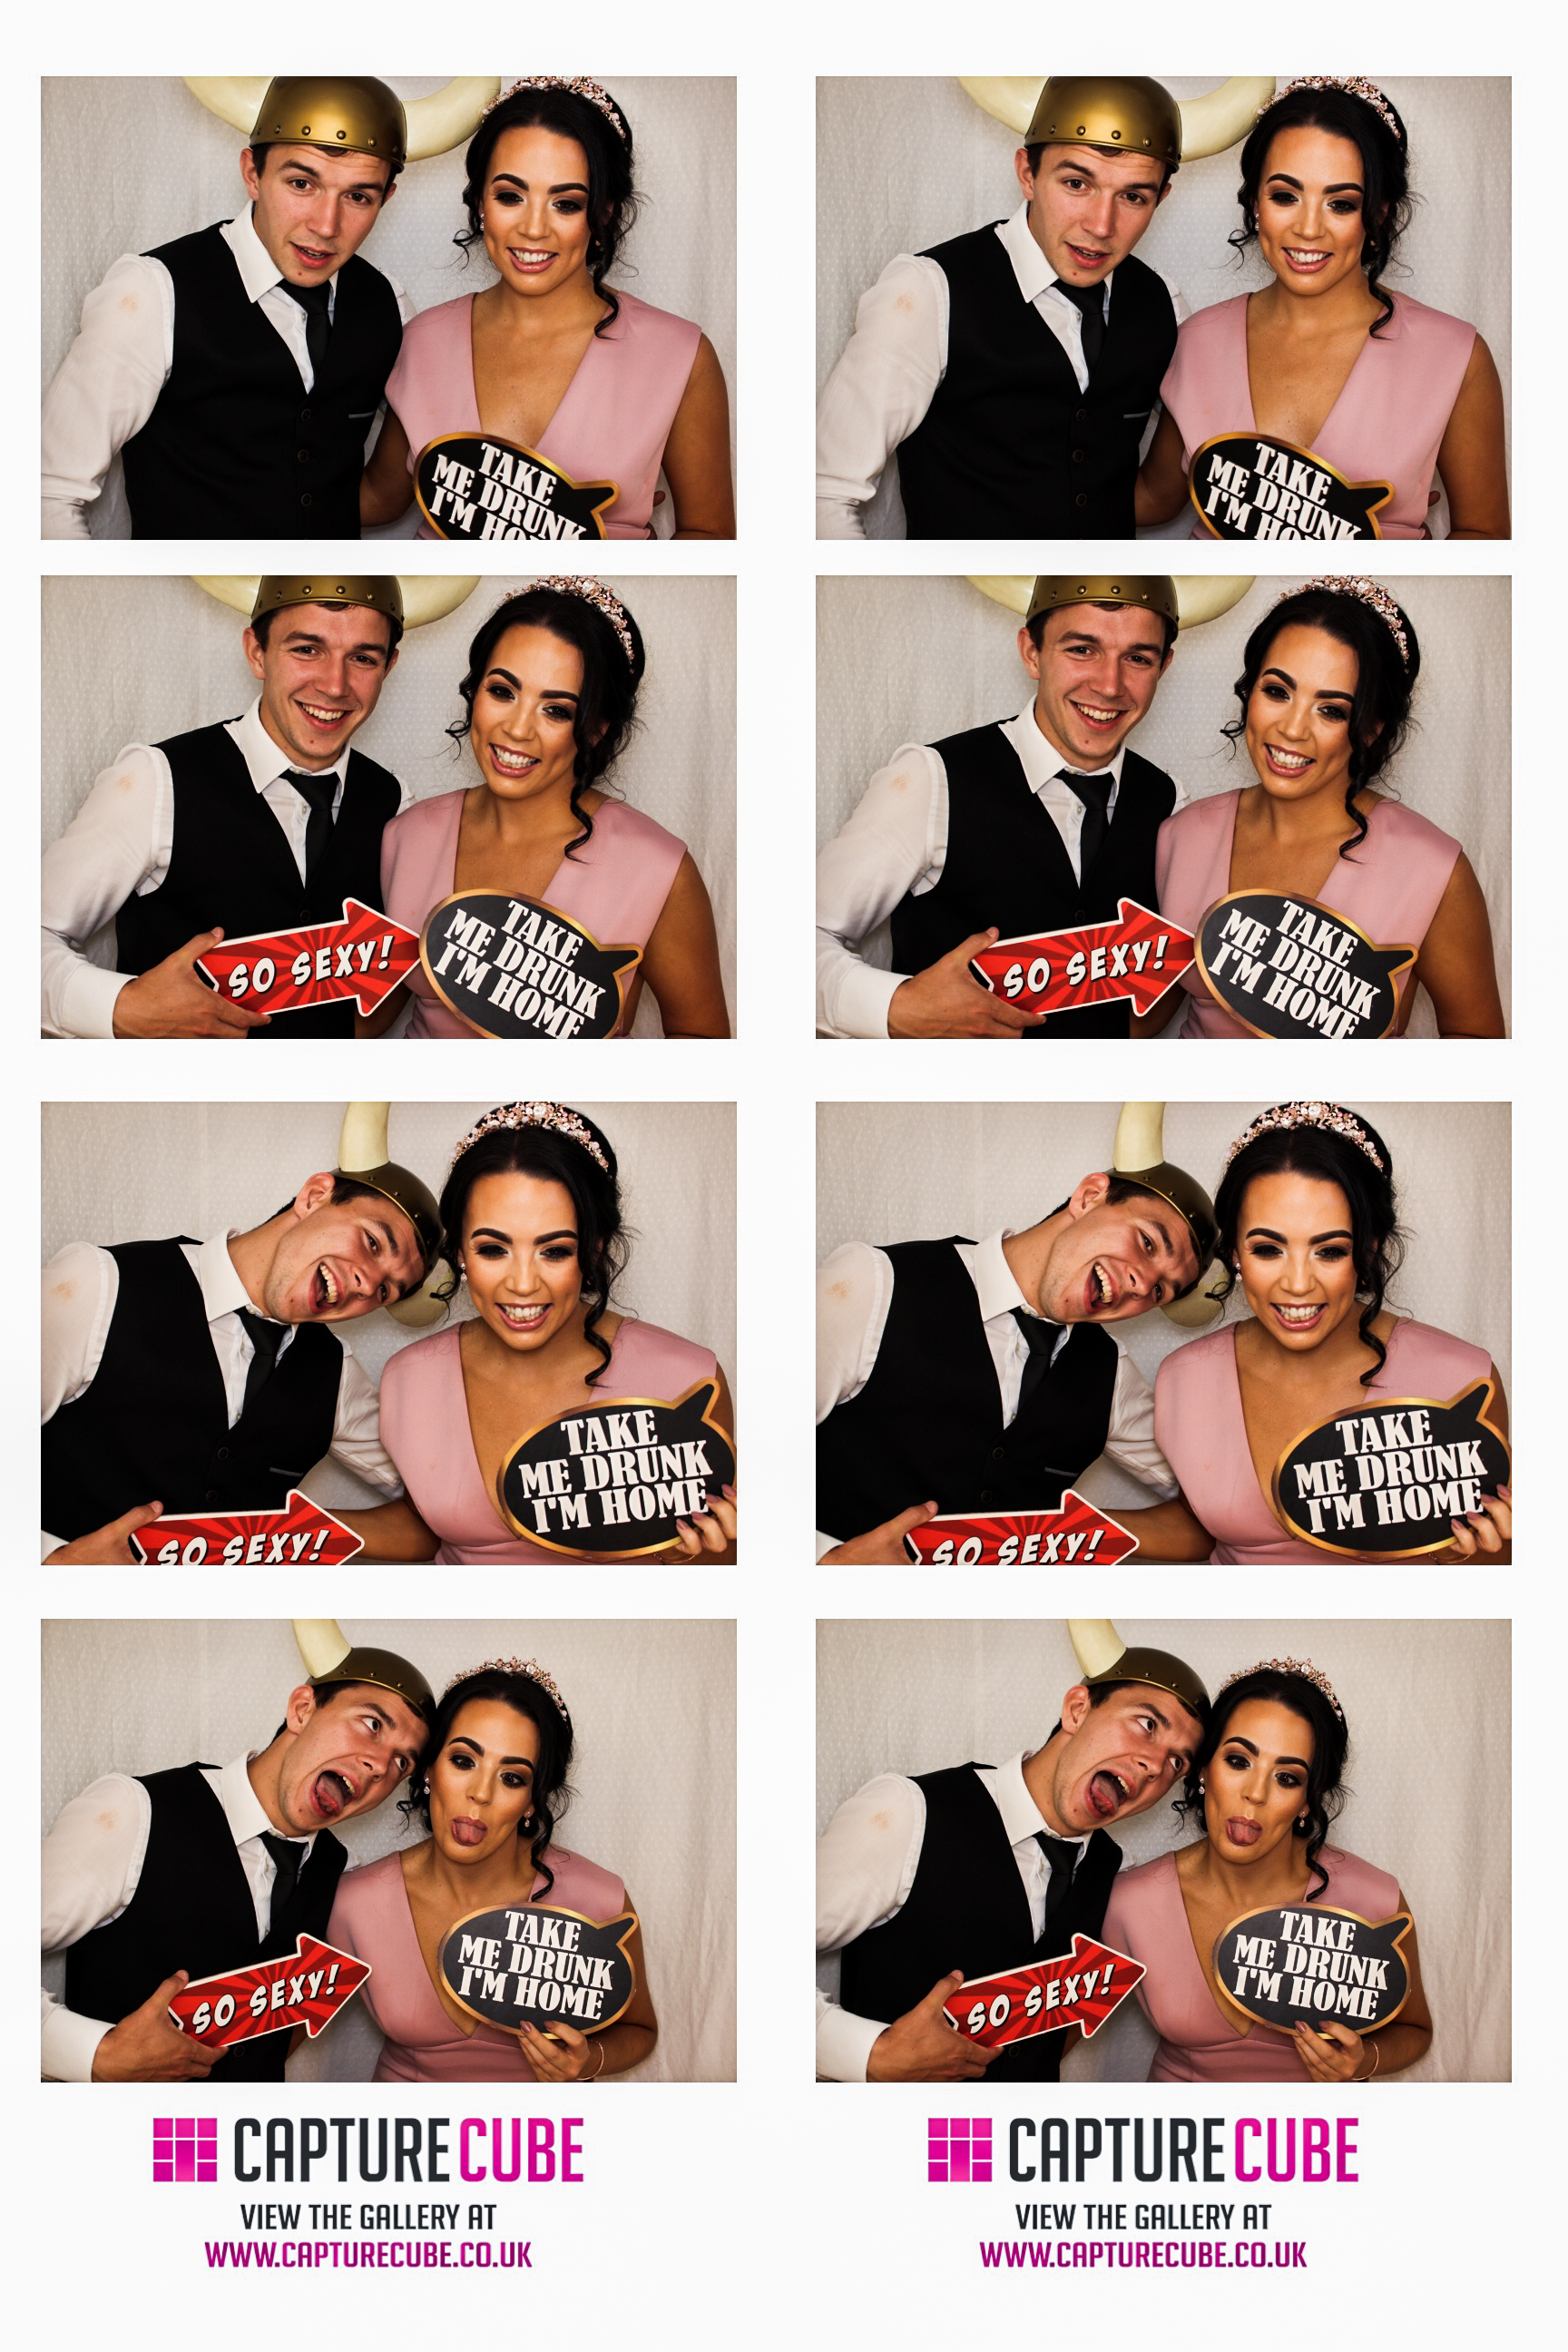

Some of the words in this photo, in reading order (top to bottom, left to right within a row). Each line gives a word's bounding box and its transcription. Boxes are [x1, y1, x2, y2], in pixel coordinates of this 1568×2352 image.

[431, 454, 475, 498] ME
[477, 477, 587, 540] DRUNK
[478, 442, 557, 505] TAKE
[1206, 454, 1250, 498] ME
[1252, 477, 1362, 540] DRUNK
[1253, 442, 1332, 505] TAKE
[429, 485, 477, 533] I'M
[1204, 485, 1252, 533] I'M
[501, 899, 584, 967] TAKE
[1276, 899, 1359, 967] TAKE
[228, 957, 276, 998] SO
[290, 935, 395, 986] SEXY!
[433, 941, 493, 995] I'M
[443, 908, 496, 957] ME
[493, 936, 606, 1020] DRUNK
[1003, 957, 1051, 998] SO
[1065, 935, 1170, 986] SEXY!
[1208, 941, 1268, 995] I'M
[1218, 908, 1271, 957] ME
[1268, 936, 1381, 1020] DRUNK
[560, 1409, 658, 1456] TAKE
[1335, 1409, 1433, 1456] TAKE
[518, 1458, 573, 1499] ME
[580, 1439, 713, 1491] DRUNK
[1293, 1458, 1348, 1499] ME
[1355, 1439, 1488, 1491] DRUNK
[531, 1493, 591, 1534] I'M
[598, 1477, 709, 1525] HOME
[1306, 1493, 1366, 1534] I'M
[1373, 1477, 1484, 1525] HOME
[157, 1536, 209, 1565] SO
[222, 1529, 330, 1565] SEXY!
[932, 1536, 984, 1565] SO
[997, 1529, 1105, 1565] SEXY!
[505, 1910, 582, 1953] TAKE
[1279, 1910, 1357, 1953] TAKE
[457, 1934, 502, 1969] ME
[507, 1943, 615, 1990] DRUNK
[1232, 1934, 1277, 1969] ME
[1282, 1943, 1390, 1990] DRUNK
[191, 1994, 236, 2034] SO
[249, 1964, 340, 2018] SEXY!
[457, 1965, 508, 2003] I'M
[513, 1975, 604, 2020] HOME
[966, 1994, 1011, 2034] SO
[1024, 1964, 1115, 2018] SEXY!
[1232, 1965, 1283, 2003] I'M
[1288, 1975, 1379, 2020] HOME
